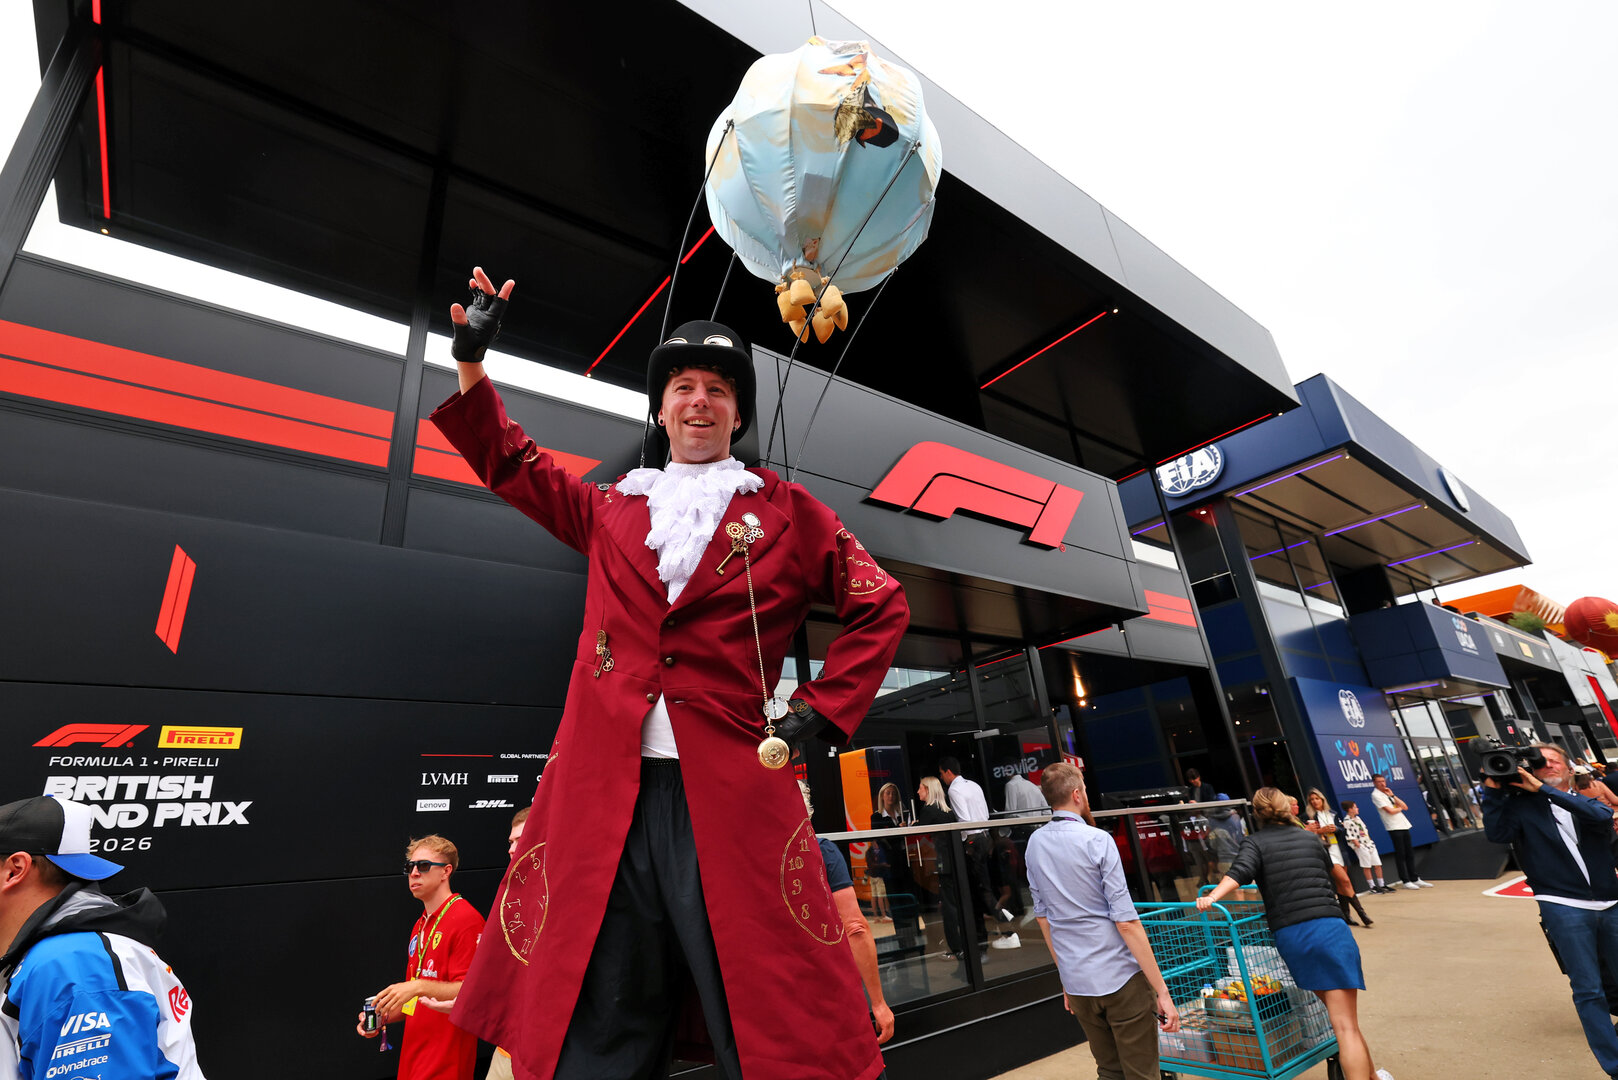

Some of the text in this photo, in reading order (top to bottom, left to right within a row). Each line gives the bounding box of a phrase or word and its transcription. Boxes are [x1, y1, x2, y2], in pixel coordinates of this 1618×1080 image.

[866, 441, 1084, 549] F1
[32, 723, 150, 748] F1
[167, 730, 235, 745] PIRELLI
[49, 756, 219, 767] FORMULA 1 PIRELLI
[1338, 759, 1372, 781] UAOA
[421, 773, 469, 785] LVMH
[487, 774, 519, 783] PIRELLI
[43, 775, 214, 801] BRITISH
[474, 799, 510, 808] DHL
[153, 801, 253, 827] PRIX
[90, 837, 152, 852] 2026
[788, 856, 805, 871] 10
[792, 878, 802, 895] 9
[801, 903, 810, 920] 8
[60, 1012, 111, 1037] VISA
[51, 1033, 112, 1060] PIRELLI
[56, 1055, 109, 1075] dynatrace
